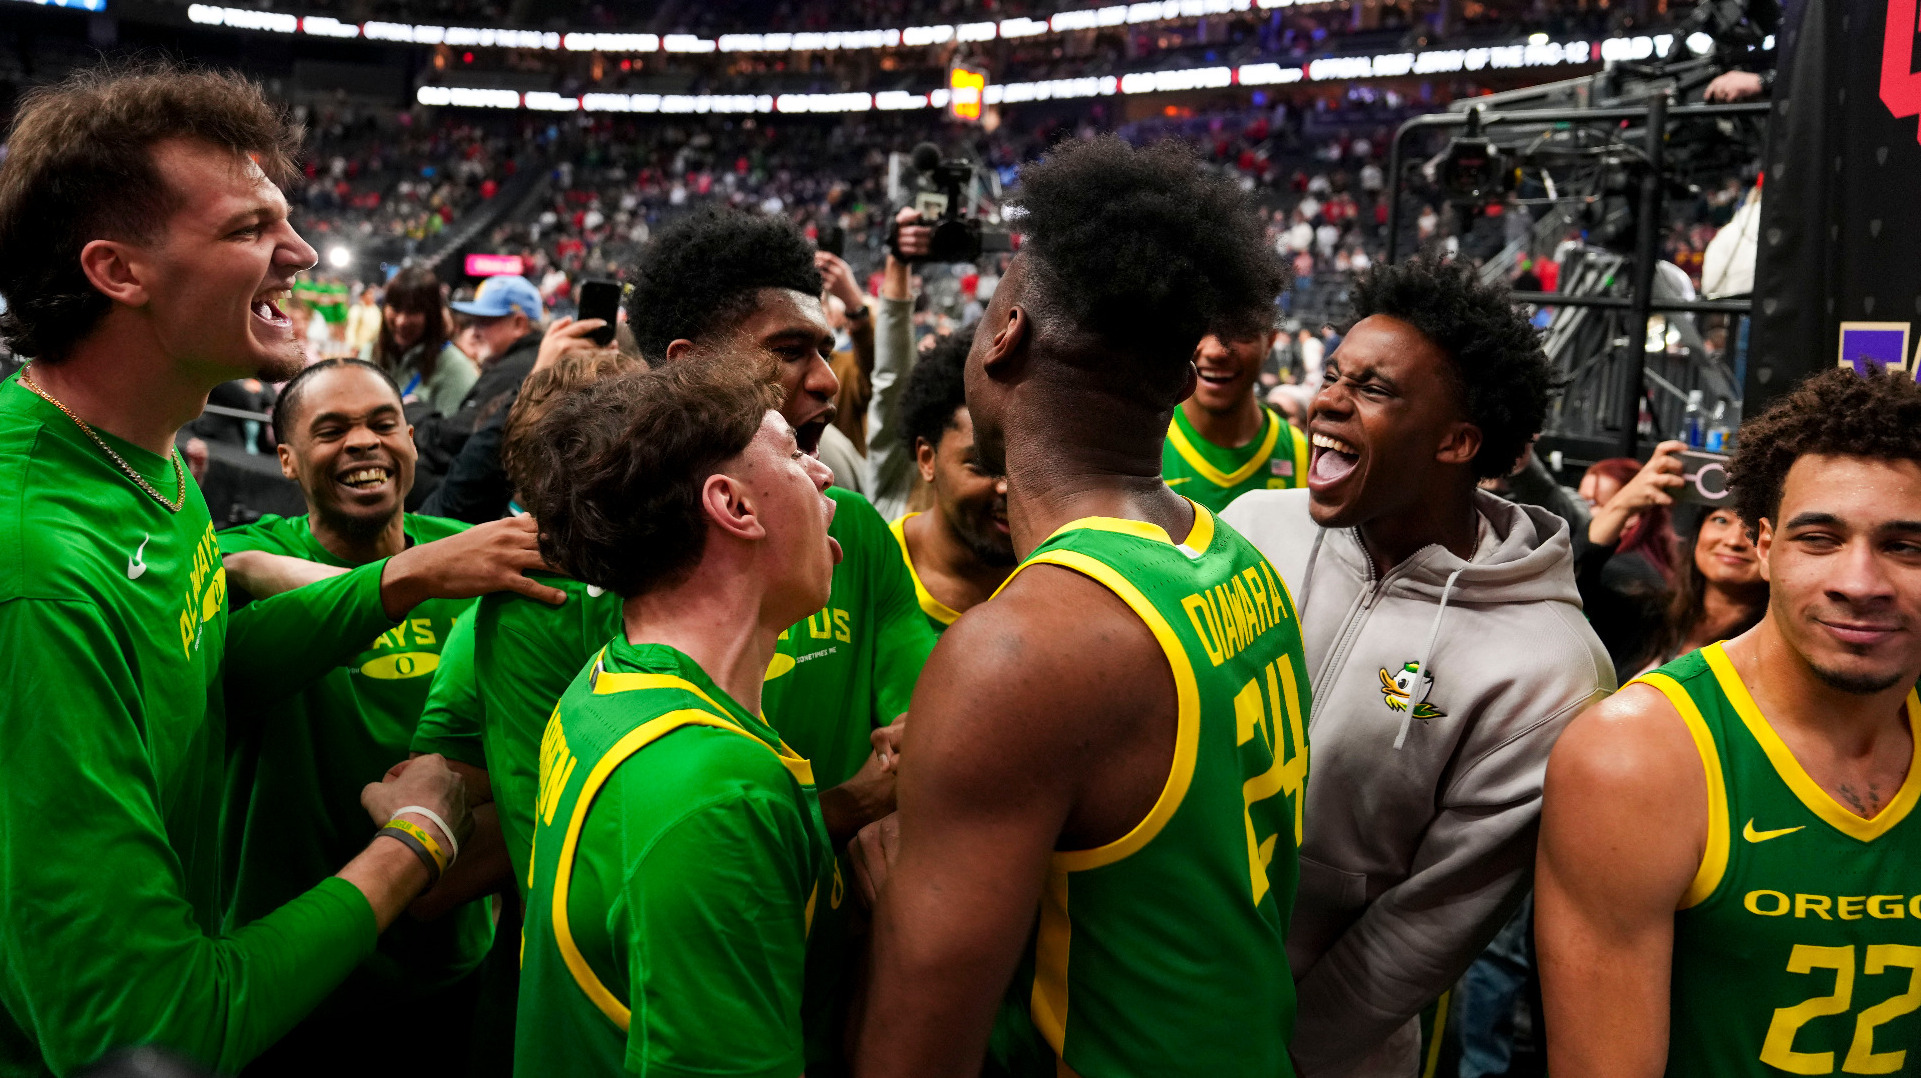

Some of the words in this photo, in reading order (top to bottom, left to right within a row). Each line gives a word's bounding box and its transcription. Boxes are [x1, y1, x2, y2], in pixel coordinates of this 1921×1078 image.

[180, 519, 220, 662] ALWAYS
[1181, 560, 1288, 667] DIAWARA
[796, 648, 828, 664] SOMETIMES
[829, 646, 837, 655] ME
[1234, 653, 1309, 908] 24
[1744, 890, 1921, 920] OREG
[1759, 943, 1921, 1075] 22
